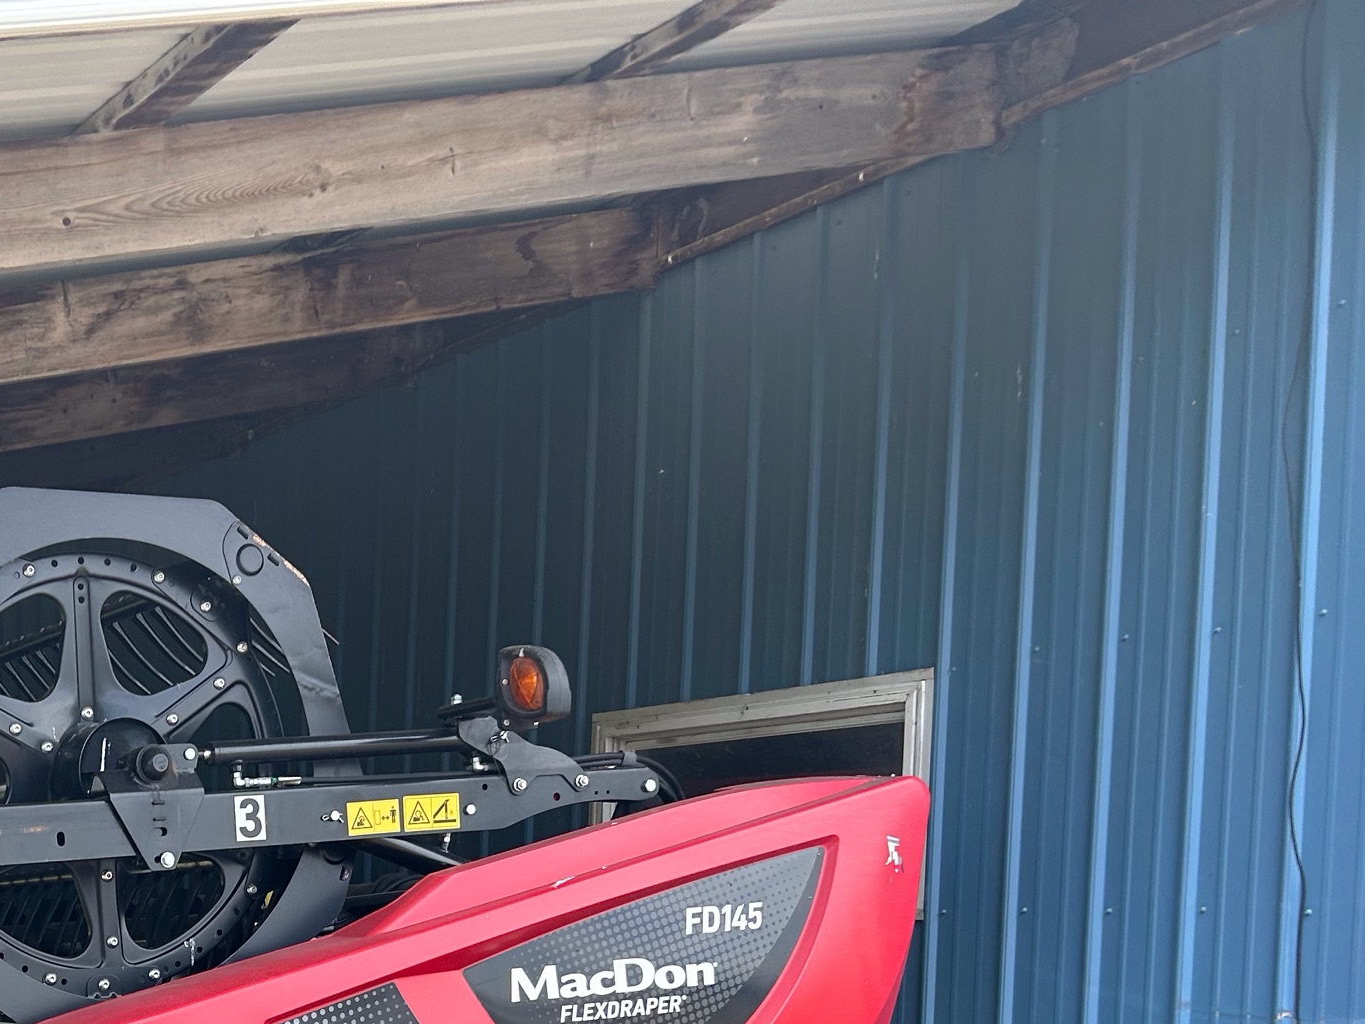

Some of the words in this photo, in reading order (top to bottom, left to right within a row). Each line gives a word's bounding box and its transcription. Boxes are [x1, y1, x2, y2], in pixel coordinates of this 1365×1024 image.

[238, 798, 262, 838] 3
[685, 902, 763, 935] FD145
[510, 957, 718, 1003] MacDon
[560, 996, 685, 1023] FLEXDRAPER
